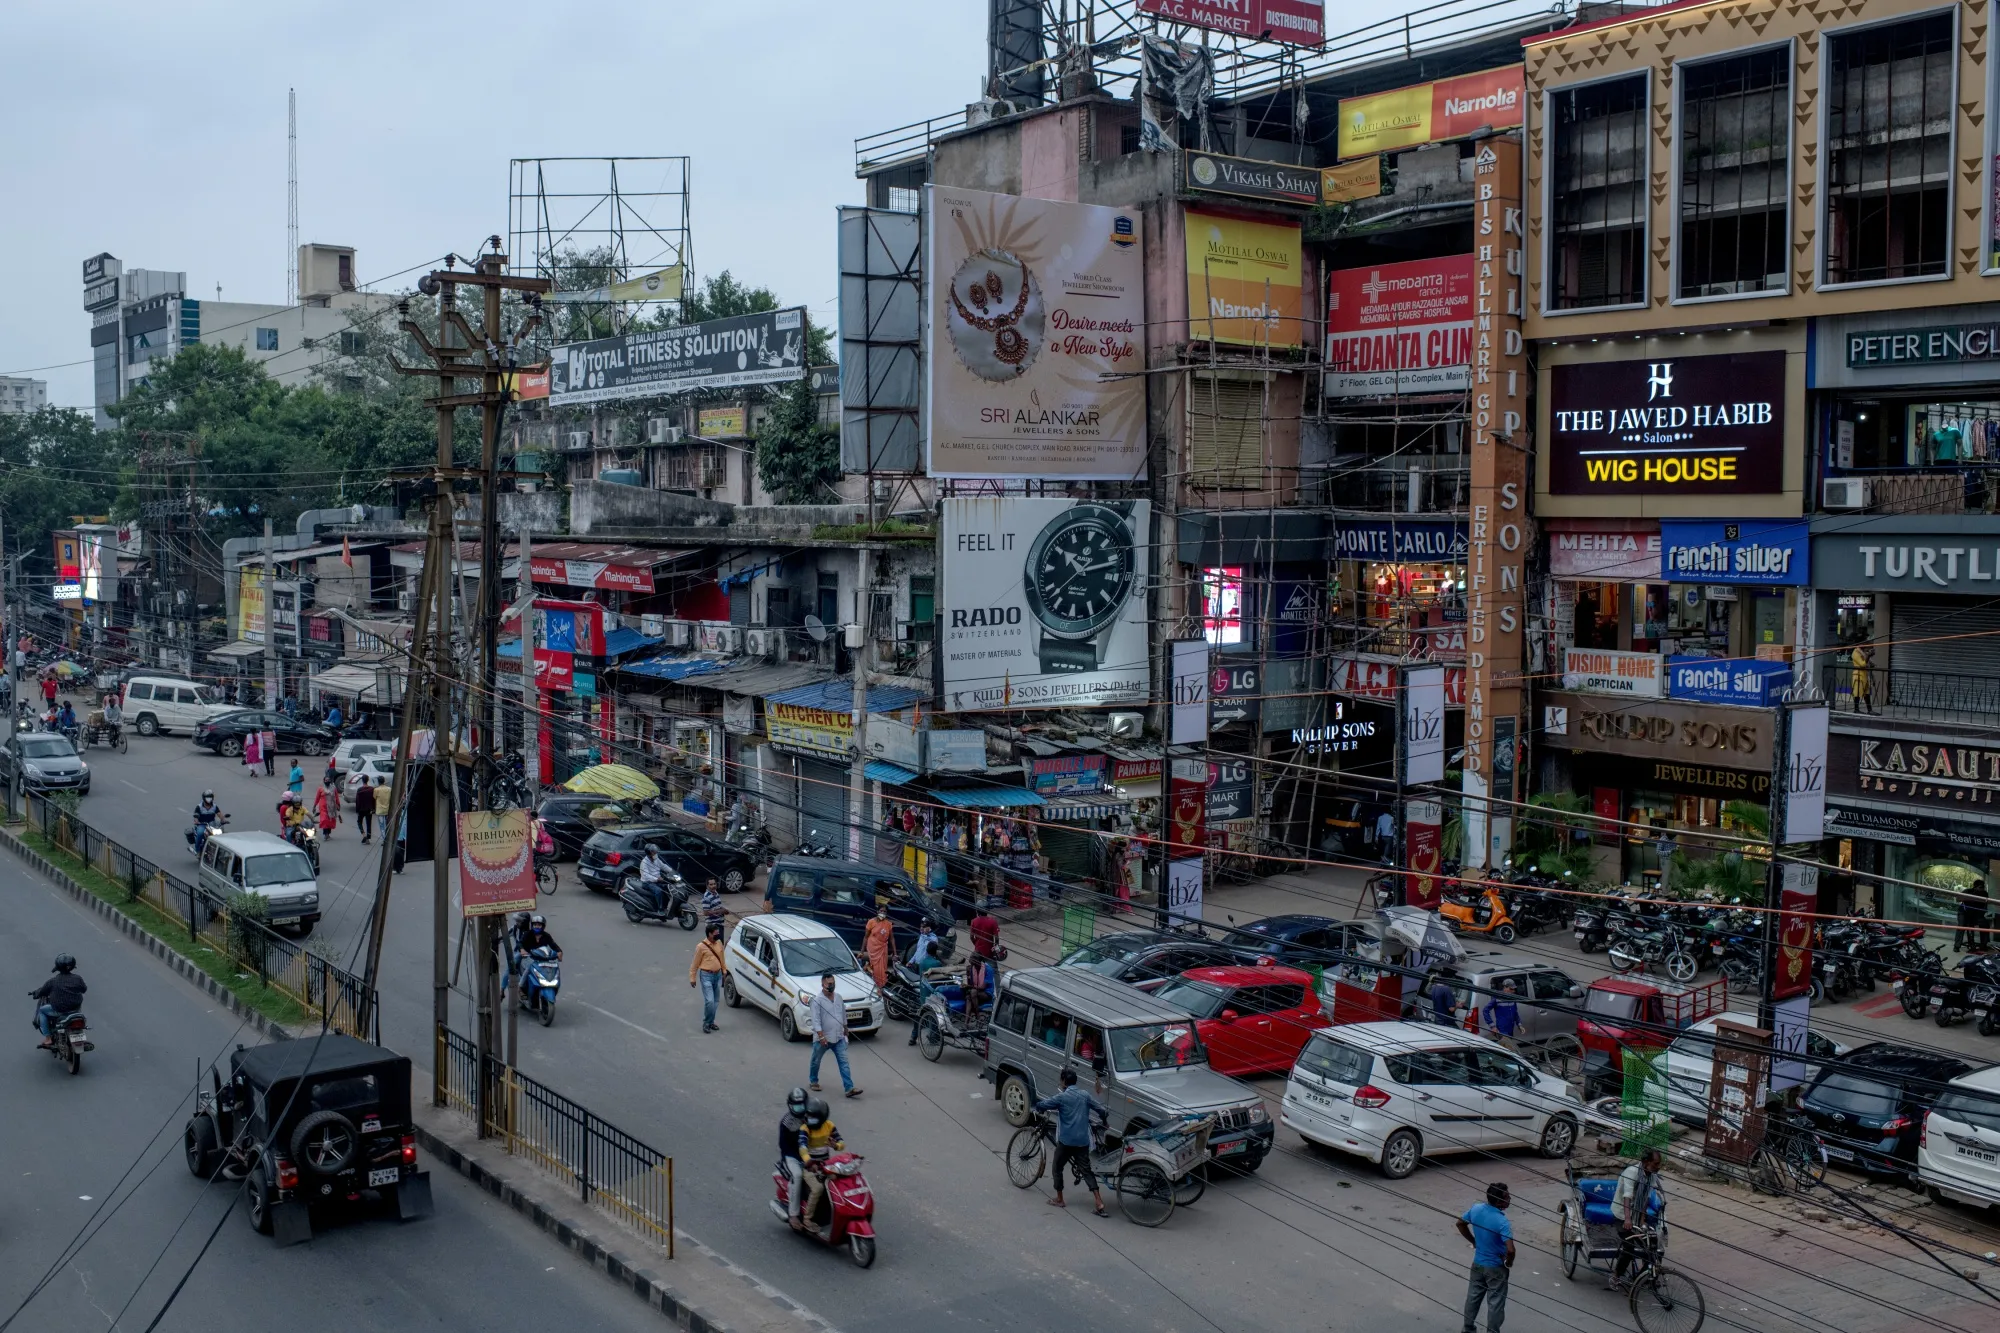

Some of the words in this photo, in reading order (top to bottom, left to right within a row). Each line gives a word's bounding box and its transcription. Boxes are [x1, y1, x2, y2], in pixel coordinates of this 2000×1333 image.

[1160, 3, 1188, 19] A.C.
[1191, 9, 1250, 32] MARKET
[1266, 9, 1319, 34] DISTRIBUTOR
[1444, 87, 1517, 117] Narnolia
[1352, 120, 1389, 135] MOTILAL
[1392, 114, 1421, 126] OSWAL
[1220, 162, 1272, 188] VIKASH
[1276, 171, 1318, 195] SAHAY
[1478, 163, 1494, 176] BIS
[943, 197, 964, 207] FOLLOW
[1479, 183, 1493, 236] BIS
[1208, 240, 1252, 258] MOTILAL
[1255, 247, 1289, 263] OSWAL
[1062, 279, 1092, 290] JEWELLERY
[1092, 283, 1125, 293] SHOWROOM
[1073, 272, 1093, 283] WORLD
[1094, 274, 1112, 284] CLASS
[1419, 287, 1442, 298] ranchi
[1360, 303, 1389, 315] MEDANTA
[1412, 298, 1444, 310] RAZZAQUE
[1444, 296, 1468, 306] ANSARI
[1360, 313, 1391, 324] MEMORIAL
[1424, 306, 1452, 318] HOSPITAL
[1476, 244, 1493, 385] HALLMARK
[775, 313, 800, 325] Aerofit
[1051, 309, 1096, 334] Desire
[1100, 319, 1133, 334] meets
[1503, 206, 1523, 438] KULDIP
[625, 336, 635, 346] SRI
[636, 332, 656, 345] BALAJI
[657, 325, 701, 342] DISTRIBUTORS
[1851, 334, 1922, 362] PETER
[1928, 329, 2000, 358] ENGL
[586, 348, 625, 373] TOTAL
[627, 339, 680, 366] FITNESS
[684, 327, 758, 358] SOLUTION
[1051, 342, 1060, 353] a
[1064, 335, 1098, 355] New
[1100, 337, 1134, 362] Style
[1332, 331, 1422, 372] MEDANTA
[690, 366, 713, 376] Showroom
[1348, 378, 1368, 387] Floor,
[1369, 376, 1383, 386] GEL
[1411, 372, 1444, 384] Complex,
[1445, 371, 1463, 381] Main
[980, 408, 1010, 424] SRI
[1014, 409, 1100, 427] ALANKAR
[1556, 409, 1604, 432] THE
[1609, 406, 1688, 434] JAWED
[1692, 402, 1773, 427] HABIB
[1013, 427, 1064, 435] JEWELLERS
[1643, 432, 1673, 444] Salon
[1586, 459, 1637, 482] WIG
[1644, 457, 1737, 483] HOUSE
[958, 533, 996, 552] FEEL
[1002, 533, 1016, 551] IT
[1335, 530, 1388, 553] MONTE
[1395, 531, 1446, 554] CARLO
[1560, 533, 1640, 552] MEHTA
[1647, 535, 1661, 552] E
[1499, 482, 1521, 634] SONS
[1668, 541, 1729, 572] ranchi
[1734, 543, 1792, 573] silver
[1859, 546, 2000, 586] TURTL
[604, 570, 641, 585] Mahindra
[1471, 505, 1488, 643] ERTIFIED
[951, 606, 1022, 628] RADO
[1280, 610, 1302, 620] MONTE
[950, 629, 1022, 640] SWITZERLAND
[950, 652, 976, 661] MASTER
[977, 652, 987, 660] OF
[988, 649, 1022, 659] MATERIALS
[1567, 652, 1612, 675] VISION
[1617, 655, 1656, 679] HOME
[1232, 670, 1255, 690] LG
[1587, 677, 1634, 691] OPTICIAN
[1677, 667, 1728, 691] ranchi
[973, 687, 1014, 703] KULDP
[1017, 686, 1048, 698] SONS
[1050, 681, 1108, 696] JEWELLERS
[1175, 676, 1204, 706] tbz
[776, 703, 833, 727] KITCHEN
[1467, 652, 1484, 772] DIAMOND
[1342, 721, 1376, 739] SONS
[1408, 706, 1441, 742] tbz
[1580, 709, 1675, 744] KULDIP
[1680, 721, 1757, 754] SONS
[1308, 740, 1359, 754] SLVER
[1033, 756, 1081, 774] MOBILE
[1083, 754, 1107, 770] HUT
[1117, 763, 1147, 778] PANNA
[1189, 760, 1204, 776] tbz
[1222, 760, 1246, 783] LG
[1789, 753, 1823, 793] tbz
[1654, 763, 1748, 790] JEWELLERS
[1860, 775, 1898, 793] The
[1908, 781, 1992, 804] Jewell
[1424, 802, 1441, 819] tbz
[1862, 813, 1918, 829] DIAMONDS
[467, 828, 525, 842] TRIBHUVAN
[1824, 825, 1868, 836] SURPRISINGLY
[1869, 830, 1913, 844] AFFORDABLE
[1974, 837, 1982, 846] is
[1801, 866, 1816, 887] tbz
[1170, 876, 1199, 907] tbz
[1426, 935, 1448, 948] Uber
[1306, 1092, 1331, 1106] 2952
